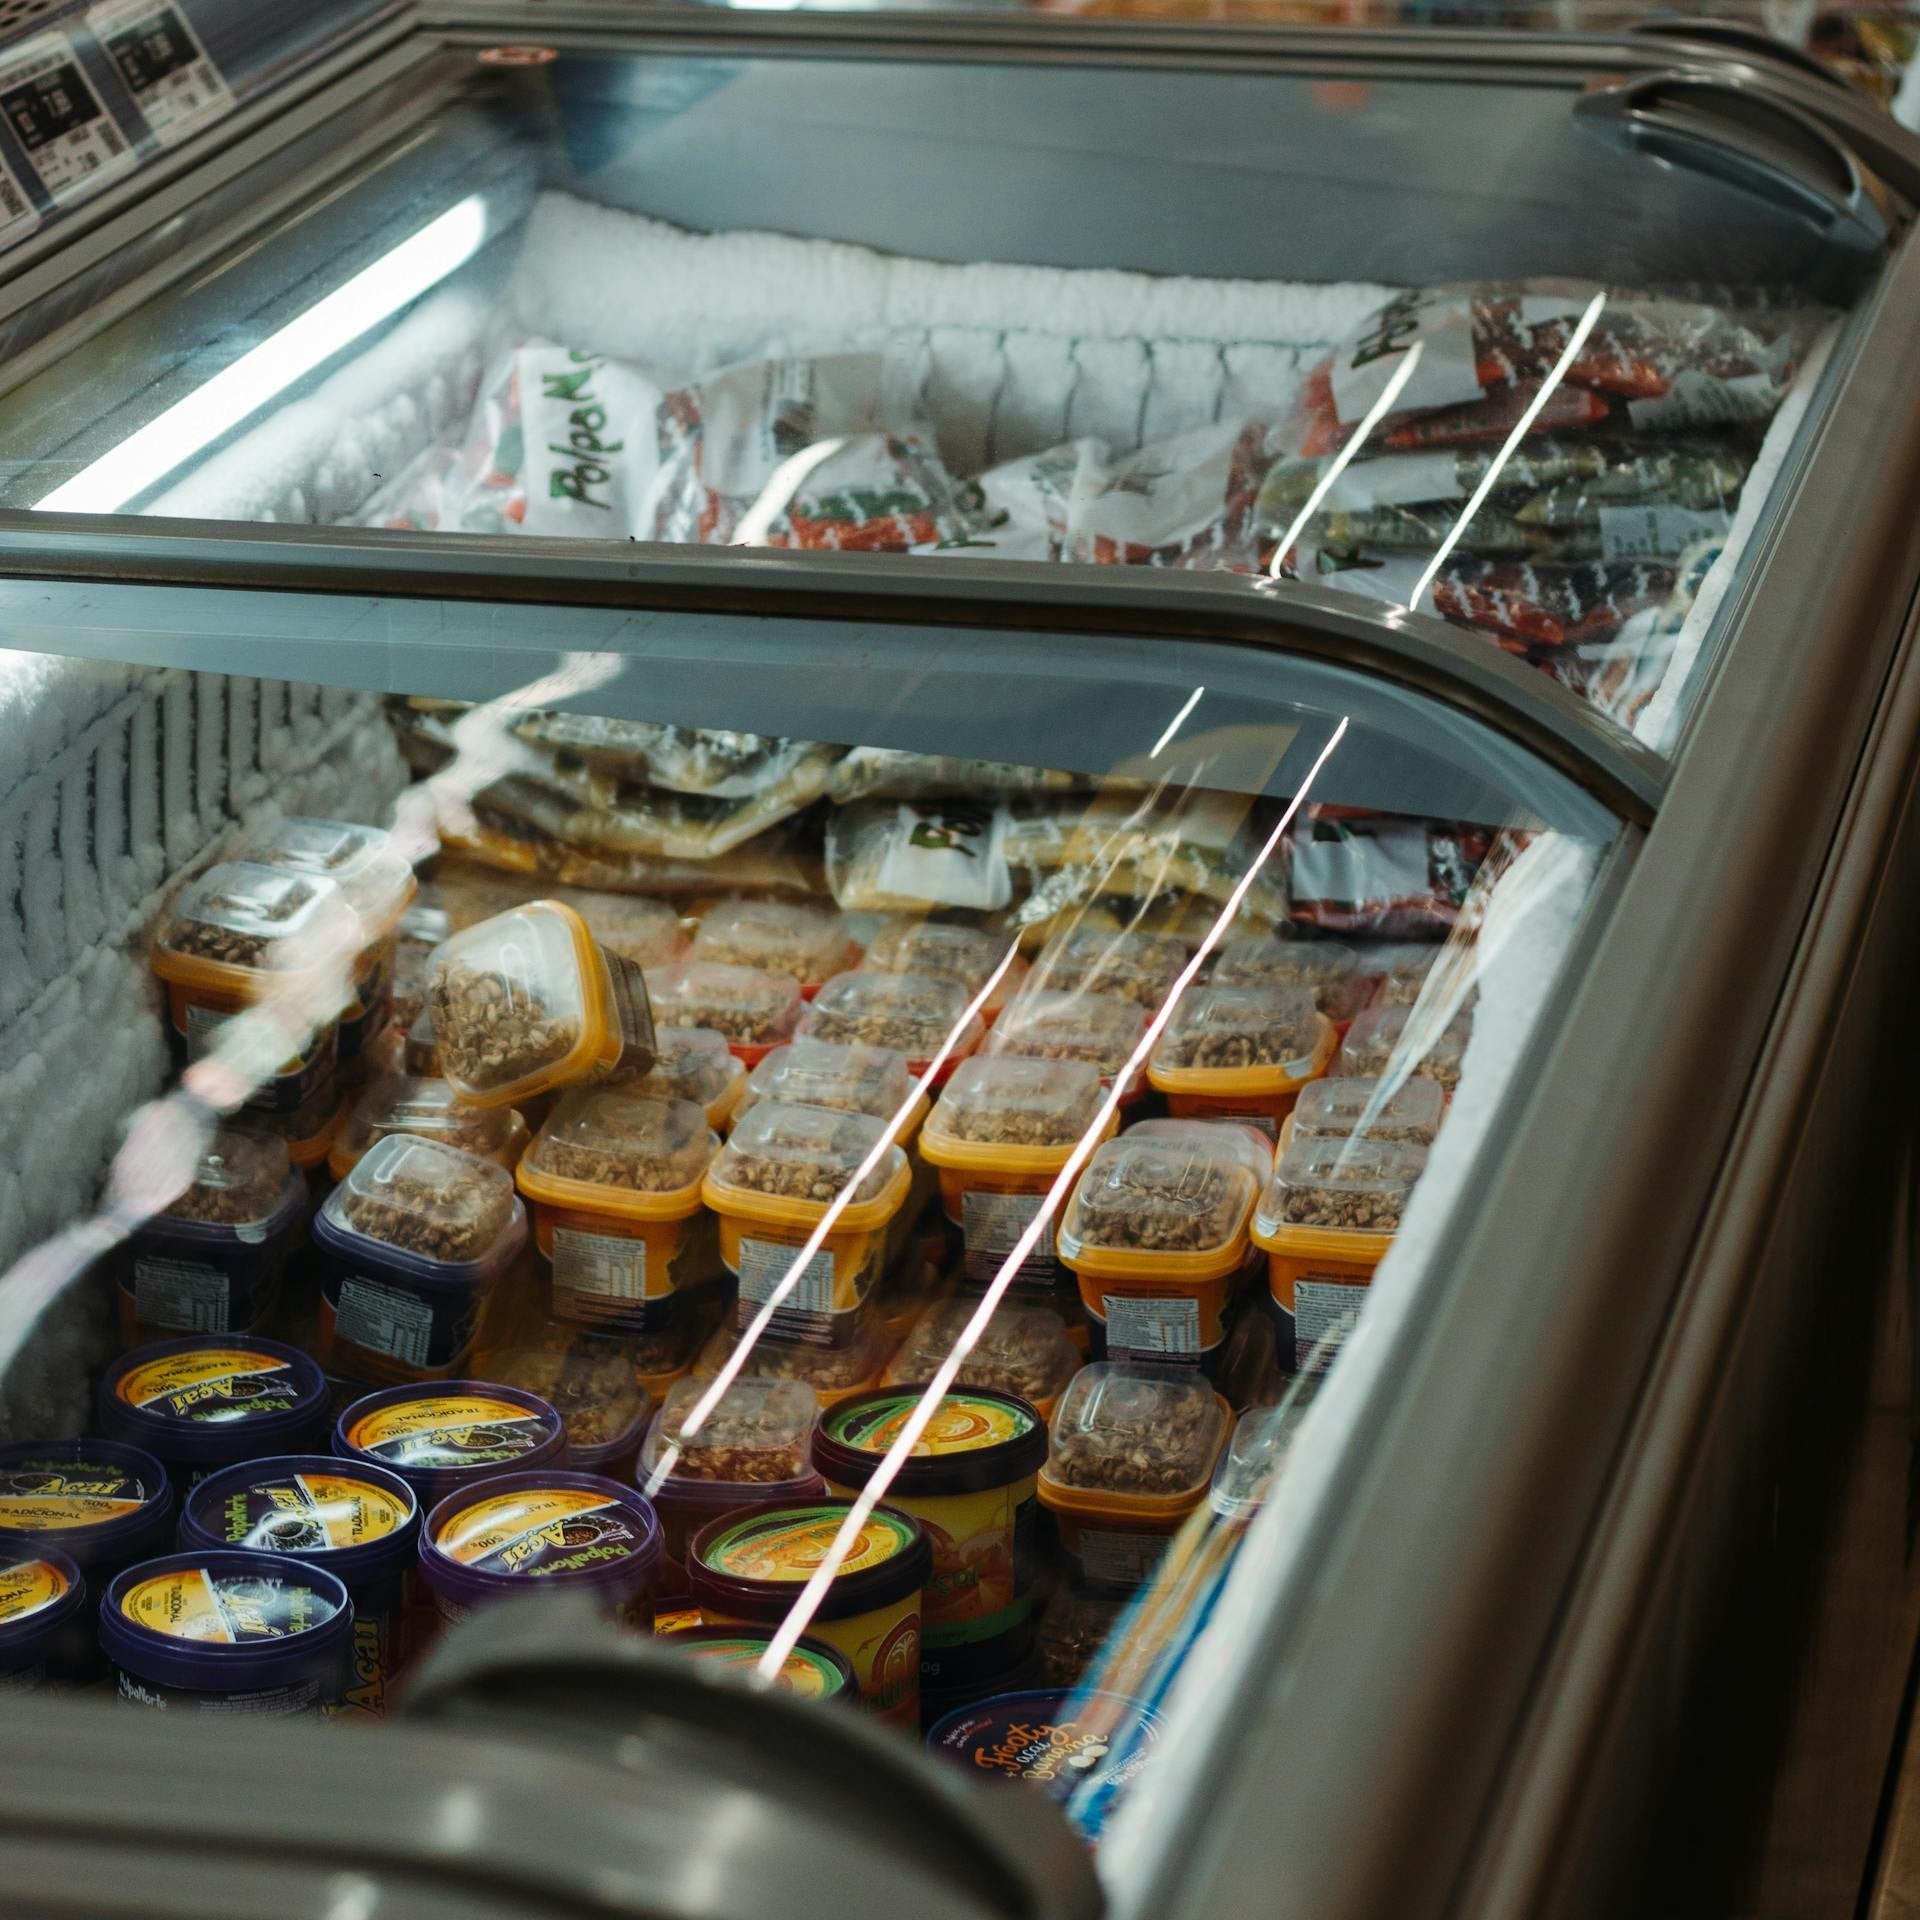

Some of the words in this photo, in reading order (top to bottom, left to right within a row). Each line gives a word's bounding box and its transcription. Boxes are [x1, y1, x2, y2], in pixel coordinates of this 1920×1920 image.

[169, 1376, 234, 1416] Açaí
[395, 1408, 479, 1422] TRADICIONAL
[27, 1477, 129, 1497] Açaí
[225, 1493, 254, 1543] PolpaNorte
[499, 1519, 567, 1574] Açaí
[528, 1544, 632, 1576] PolpaNorte
[119, 1671, 168, 1712] PolpaNorte
[974, 1722, 1077, 1772] Frooty
[1022, 1733, 1108, 1781] Banana
